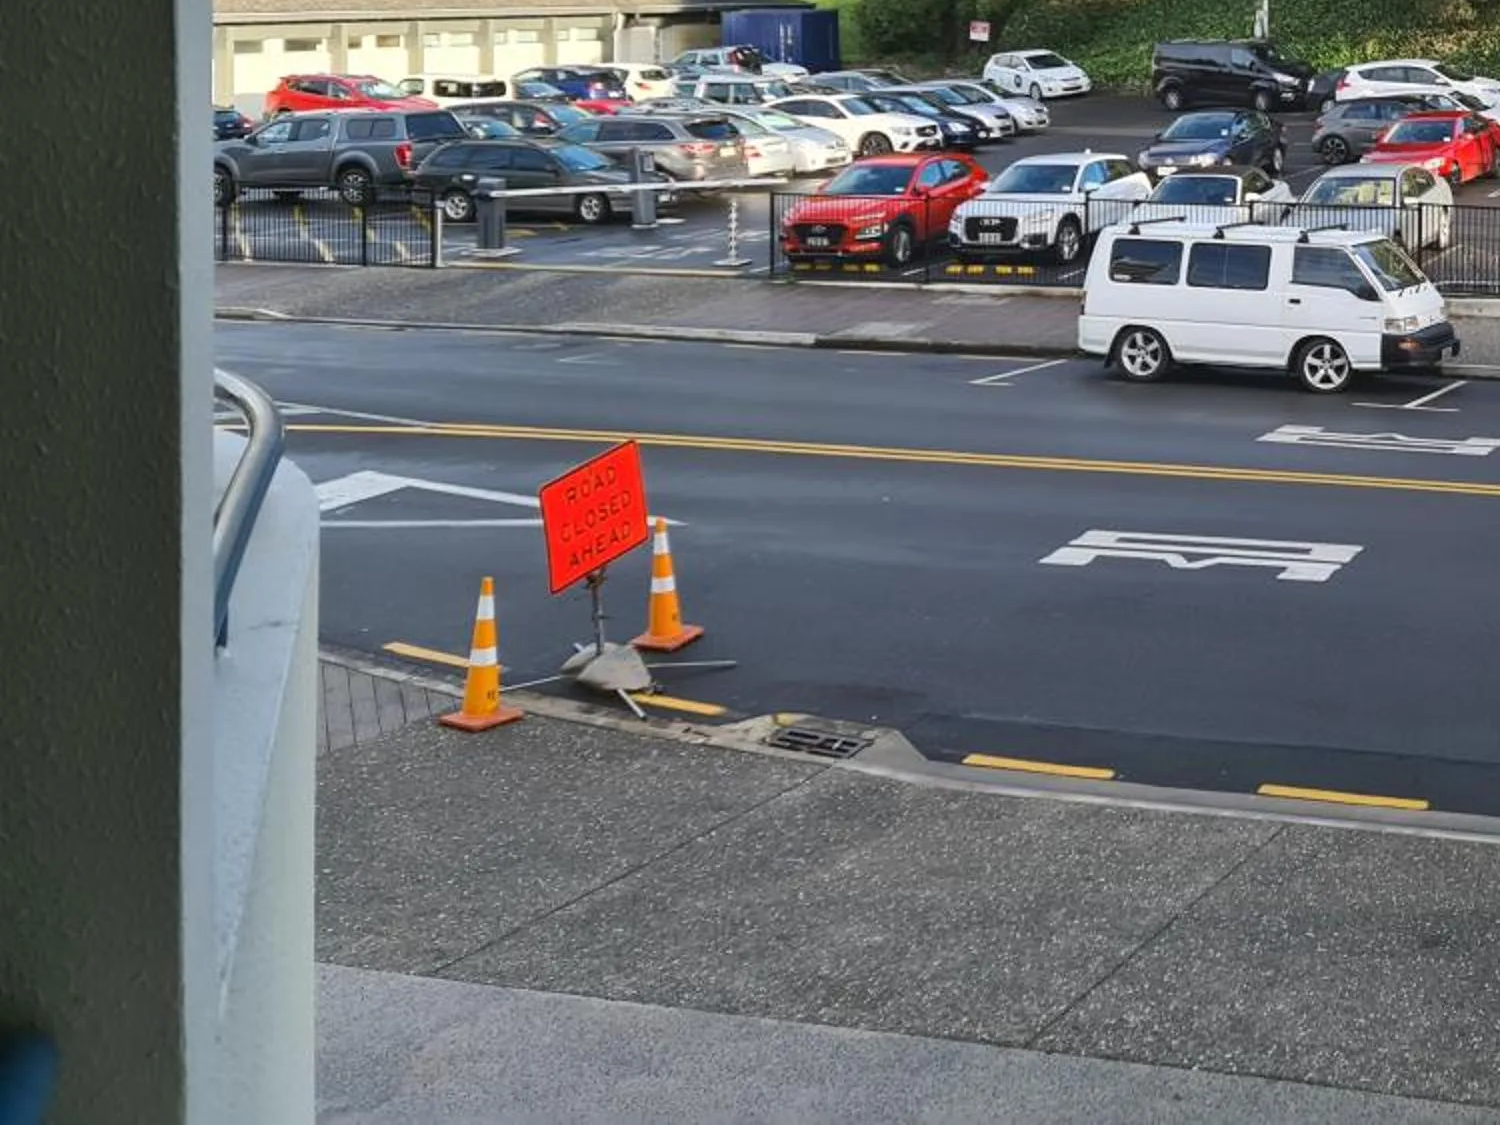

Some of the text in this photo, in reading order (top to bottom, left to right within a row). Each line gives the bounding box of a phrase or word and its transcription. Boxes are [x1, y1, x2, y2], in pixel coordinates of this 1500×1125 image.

[565, 466, 616, 505] ROAD
[560, 490, 632, 542] CLOSED
[569, 521, 632, 567] AHEAD
